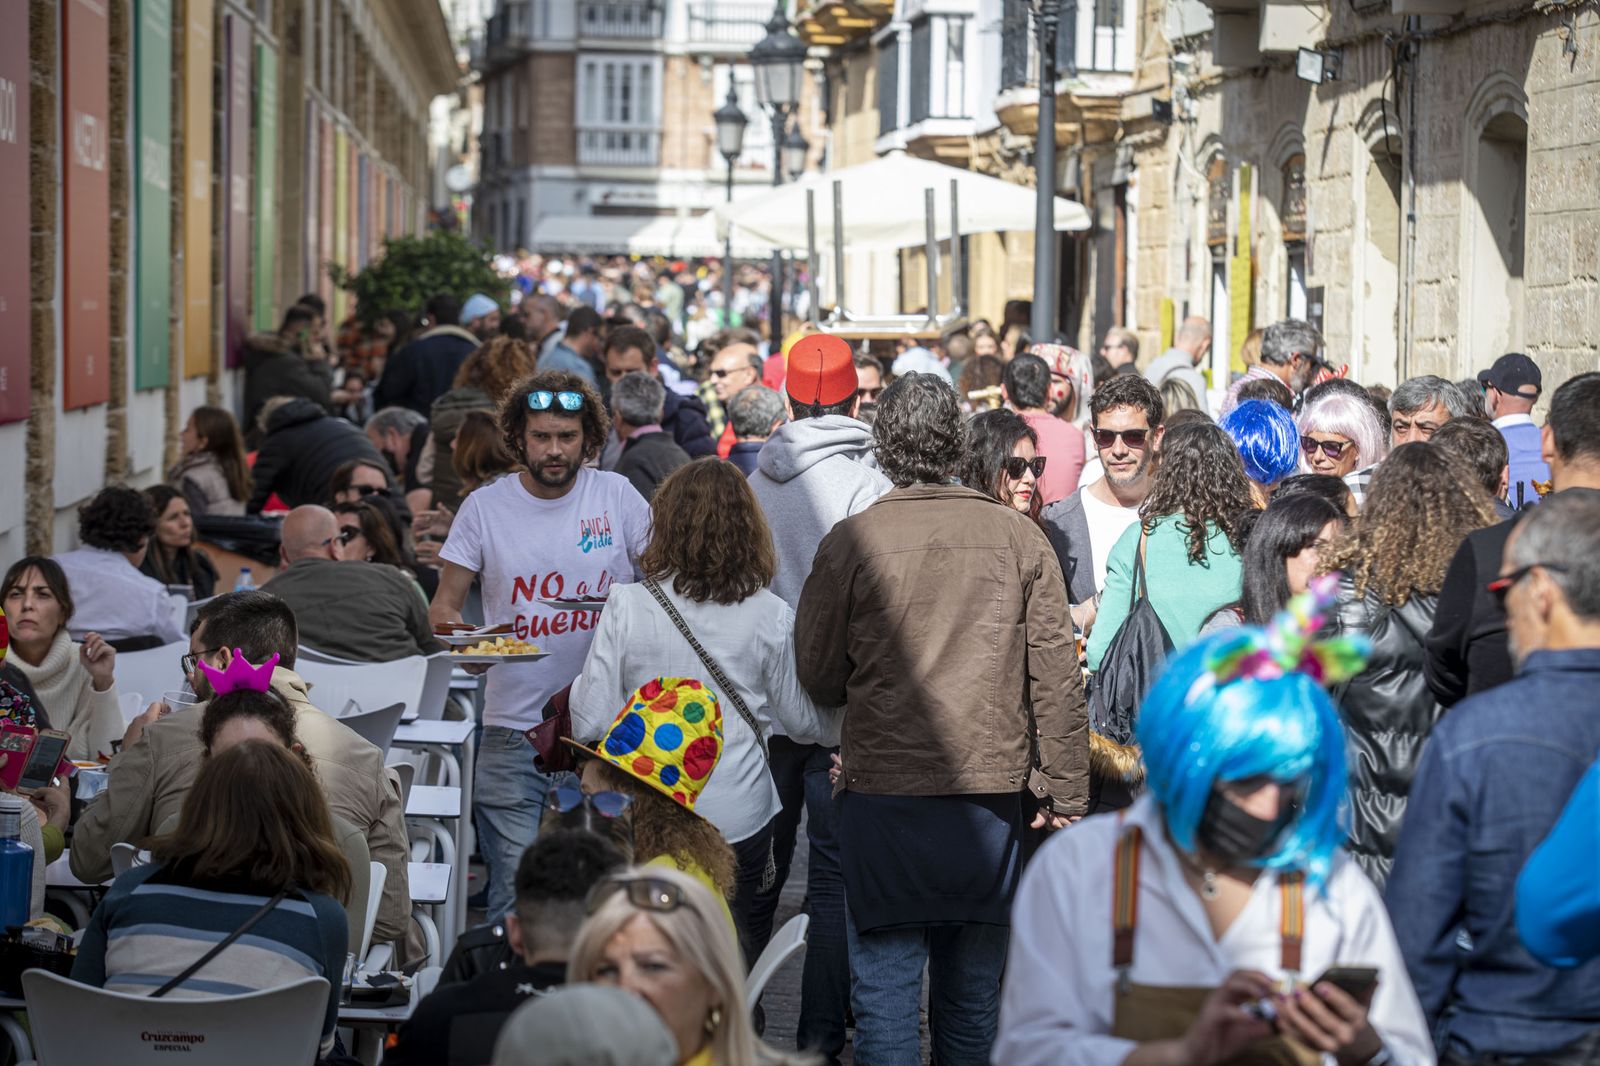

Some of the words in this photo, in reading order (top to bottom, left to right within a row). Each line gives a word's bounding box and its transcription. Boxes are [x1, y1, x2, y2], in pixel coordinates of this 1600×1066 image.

[511, 570, 565, 605] NO
[576, 580, 592, 595] a
[140, 1030, 205, 1045] Cruzcampo
[153, 1044, 192, 1052] ESPECIAL
